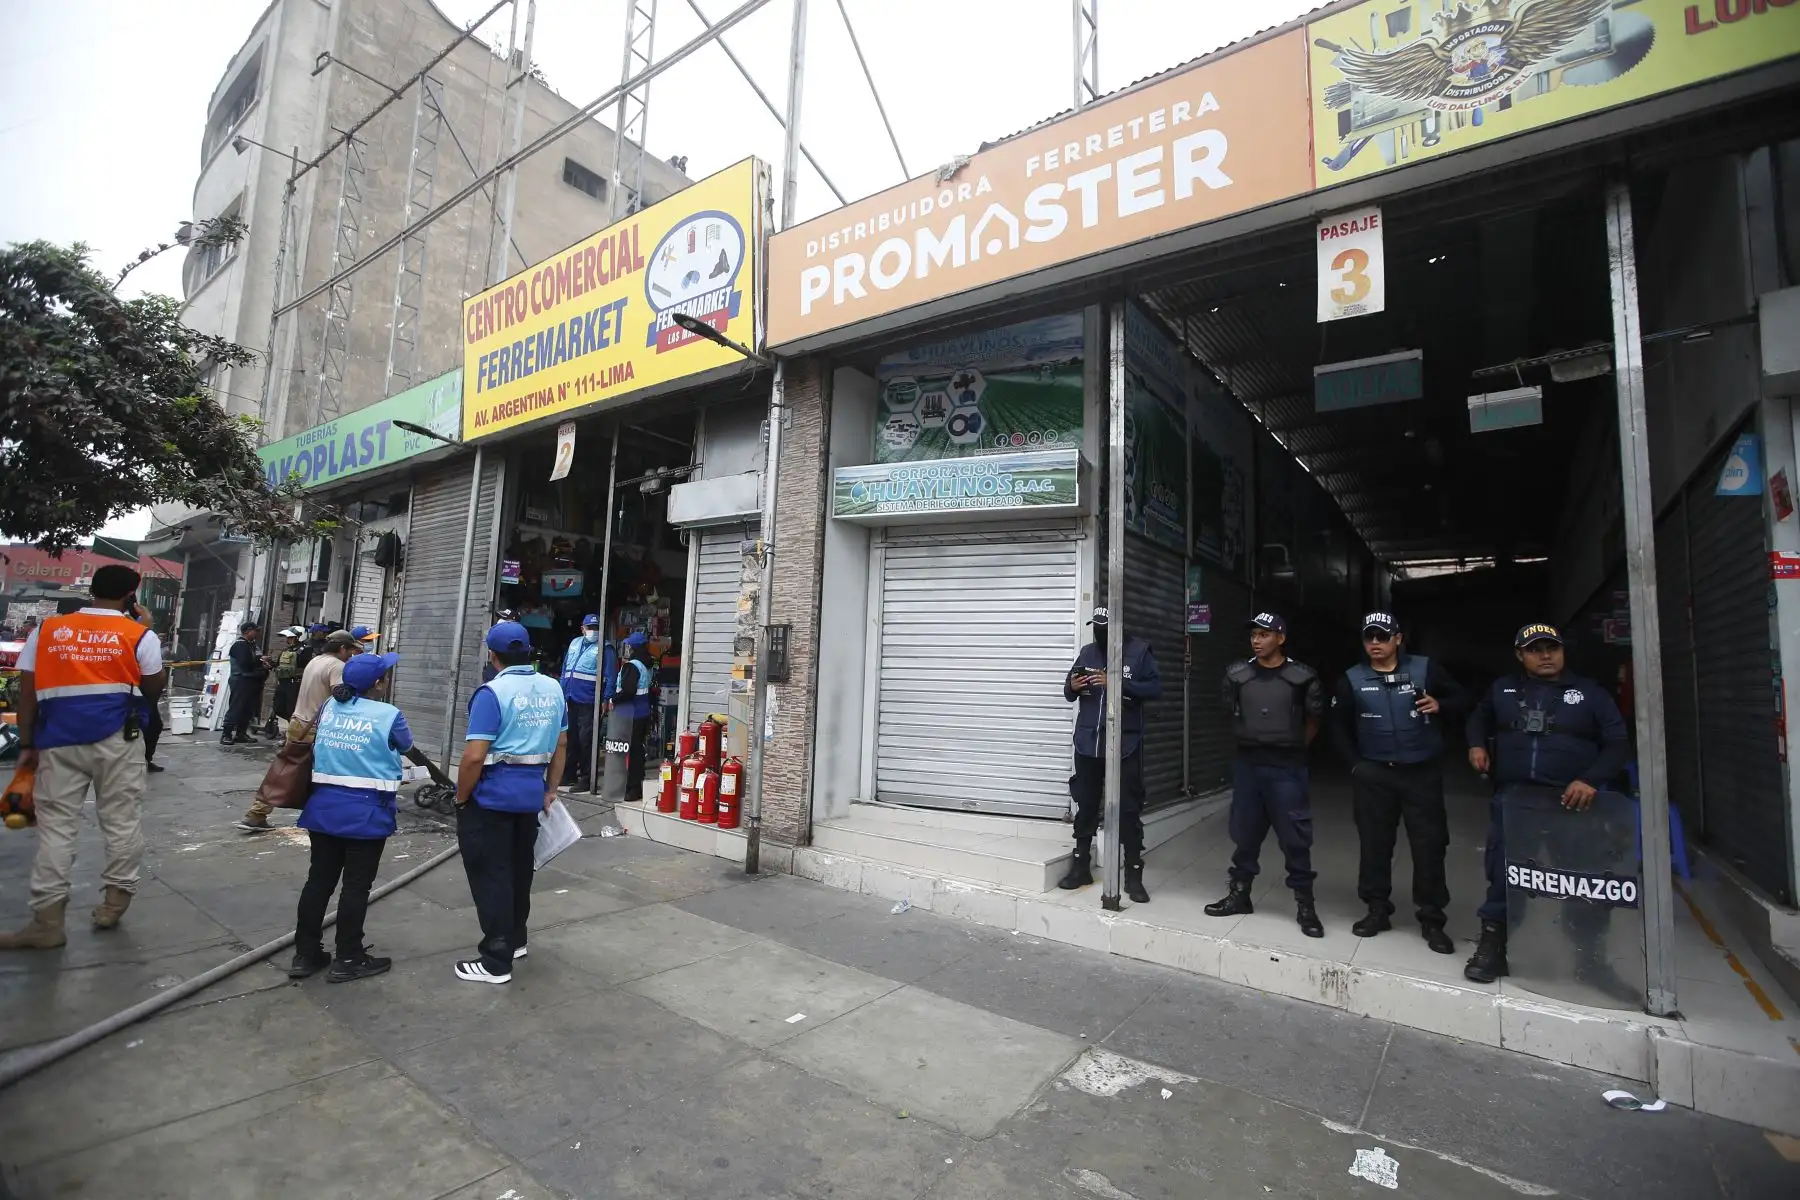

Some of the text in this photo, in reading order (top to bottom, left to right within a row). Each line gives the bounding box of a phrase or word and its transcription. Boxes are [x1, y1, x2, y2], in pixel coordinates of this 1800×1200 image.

[1685, 0, 1799, 35] LU
[1444, 24, 1506, 51] IMPORTADORA
[1446, 72, 1513, 97] DISTRIBUIDORA
[1427, 99, 1447, 111] LUIS
[806, 91, 1220, 258] DISTRIBUIDORA FERRETERA
[800, 128, 1234, 316] PROMASTER
[1320, 215, 1379, 241] PASAJE
[466, 223, 645, 345] CENTRO COMERCIAL
[1330, 248, 1371, 305] 3
[477, 296, 629, 394] FERREMARKET
[667, 331, 681, 345] LAS
[474, 409, 489, 428] AV.
[491, 386, 555, 423] ARGENTINA
[574, 361, 635, 396] 111-LIMA
[296, 423, 338, 448] TUBERÍAS
[404, 437, 421, 452] PVC
[263, 419, 392, 493] AKOPLAST
[557, 442, 572, 473] 2
[888, 460, 1000, 482] CORPORACIÓN
[868, 474, 1055, 502] HUAYLINOS S.A.C.
[877, 495, 1023, 512] SISTEMA DE RIEGO TECNIFICADO
[1366, 613, 1391, 624] UNOES
[1523, 625, 1557, 638] UNOES
[77, 632, 120, 645] LIMA
[334, 717, 373, 733] LIMA
[324, 739, 364, 751] CONTROL
[1508, 865, 1637, 902] SERENAZGO
